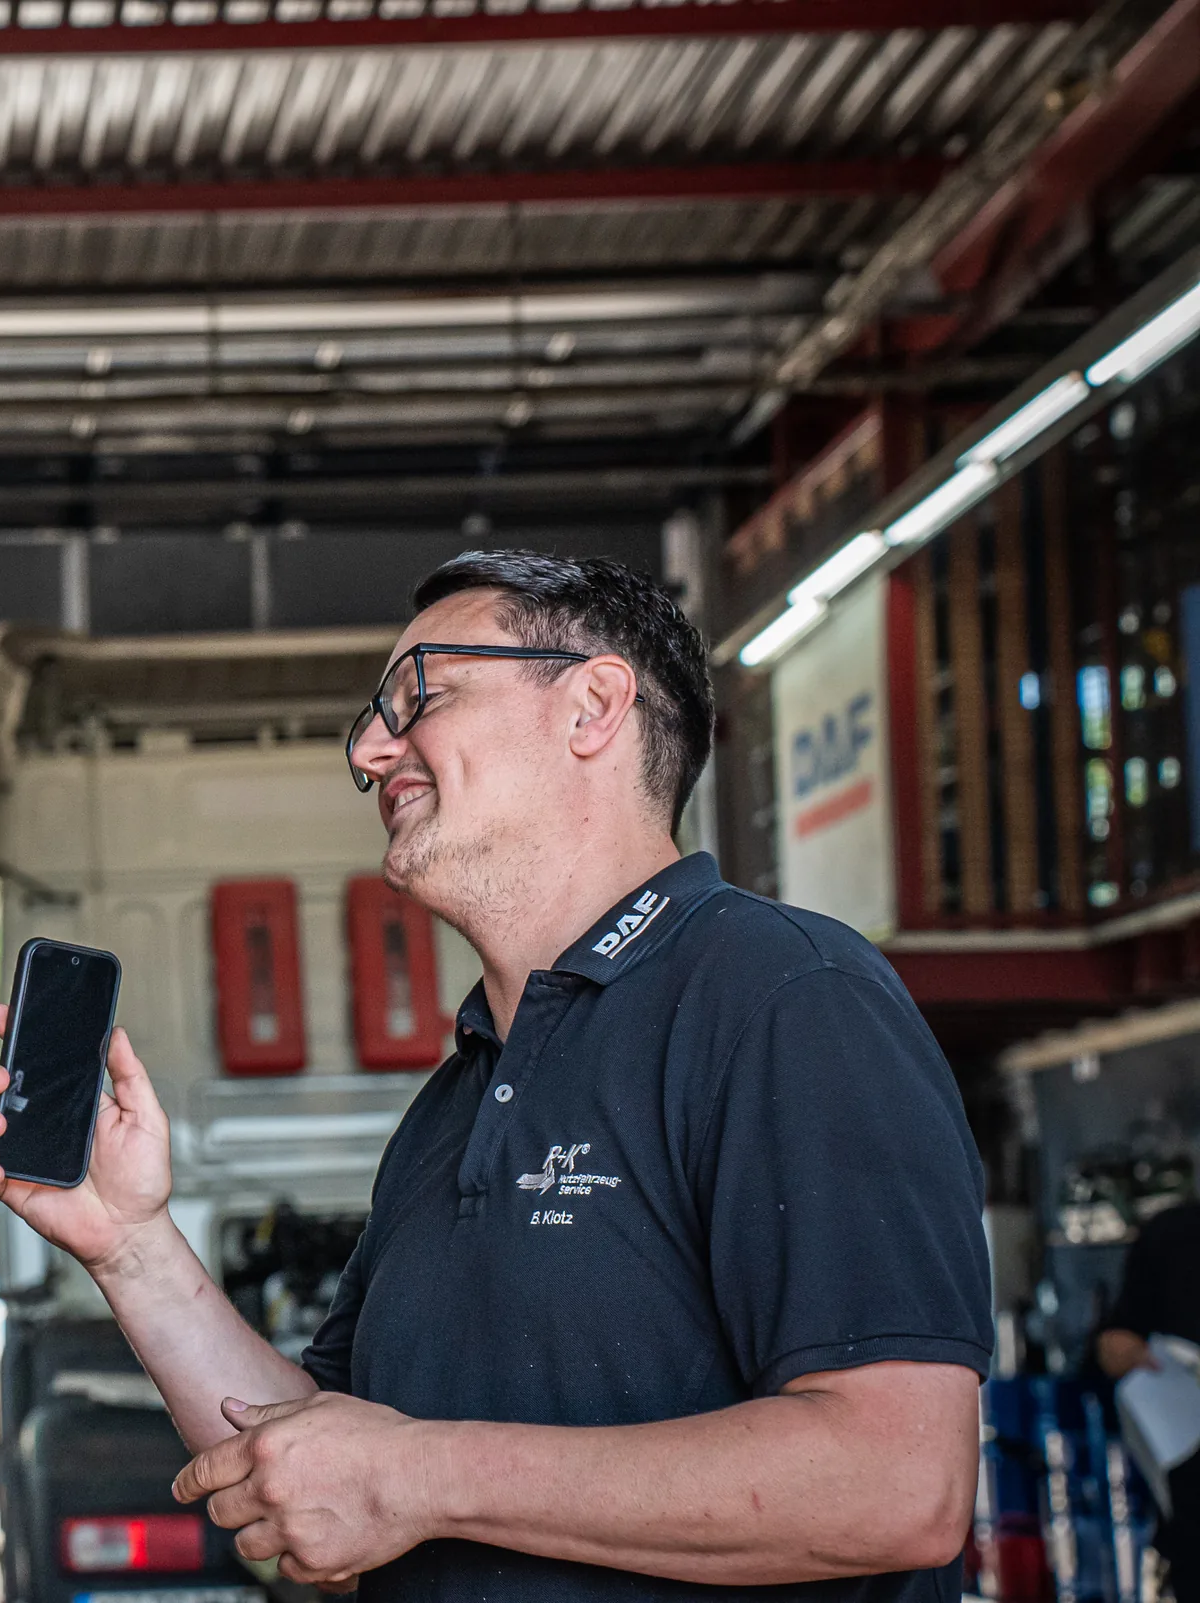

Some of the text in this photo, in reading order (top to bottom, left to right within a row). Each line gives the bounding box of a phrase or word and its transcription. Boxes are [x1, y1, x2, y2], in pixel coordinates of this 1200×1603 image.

[790, 690, 872, 800] DAF
[591, 889, 659, 955] DAF
[542, 1210, 574, 1225] Klotz
